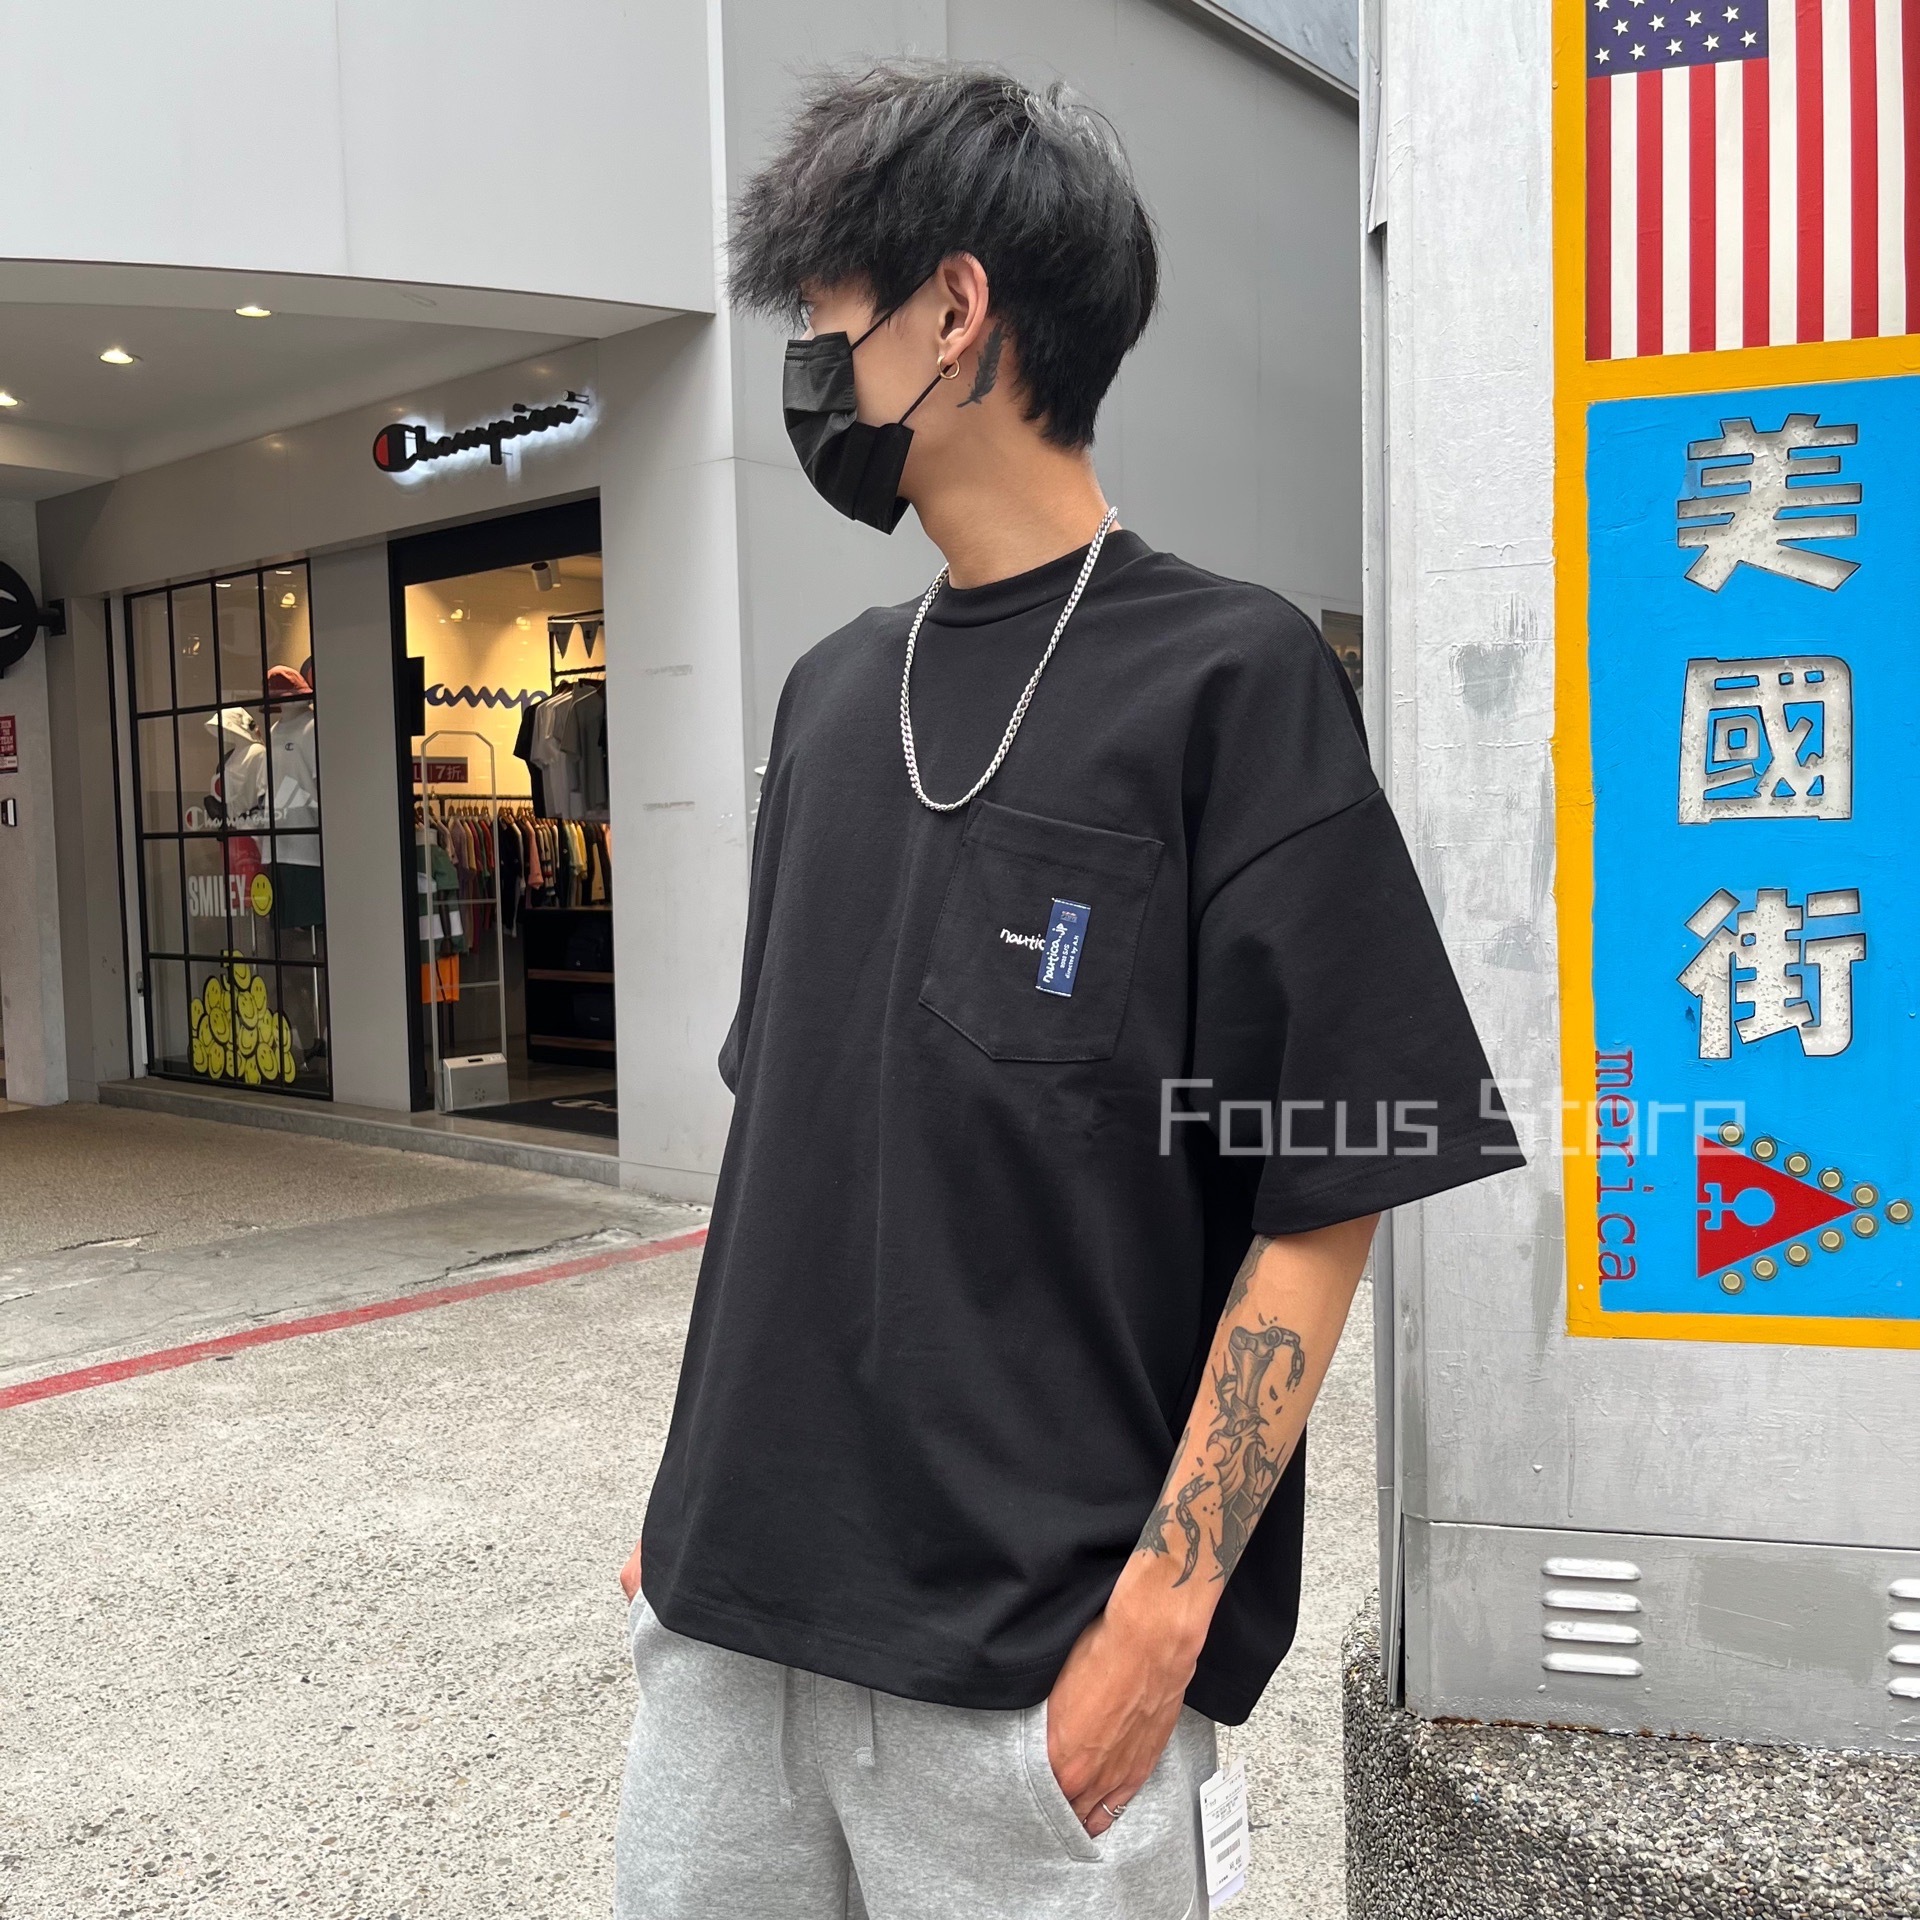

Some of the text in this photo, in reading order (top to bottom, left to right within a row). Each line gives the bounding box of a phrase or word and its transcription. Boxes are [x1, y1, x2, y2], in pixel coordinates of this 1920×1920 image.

[373, 403, 581, 472] Champion
[1677, 413, 1866, 1059] 美國街
[188, 874, 247, 917] SMILEY
[1042, 922, 1069, 983] nautica.jp
[1595, 1049, 1654, 1287] merica
